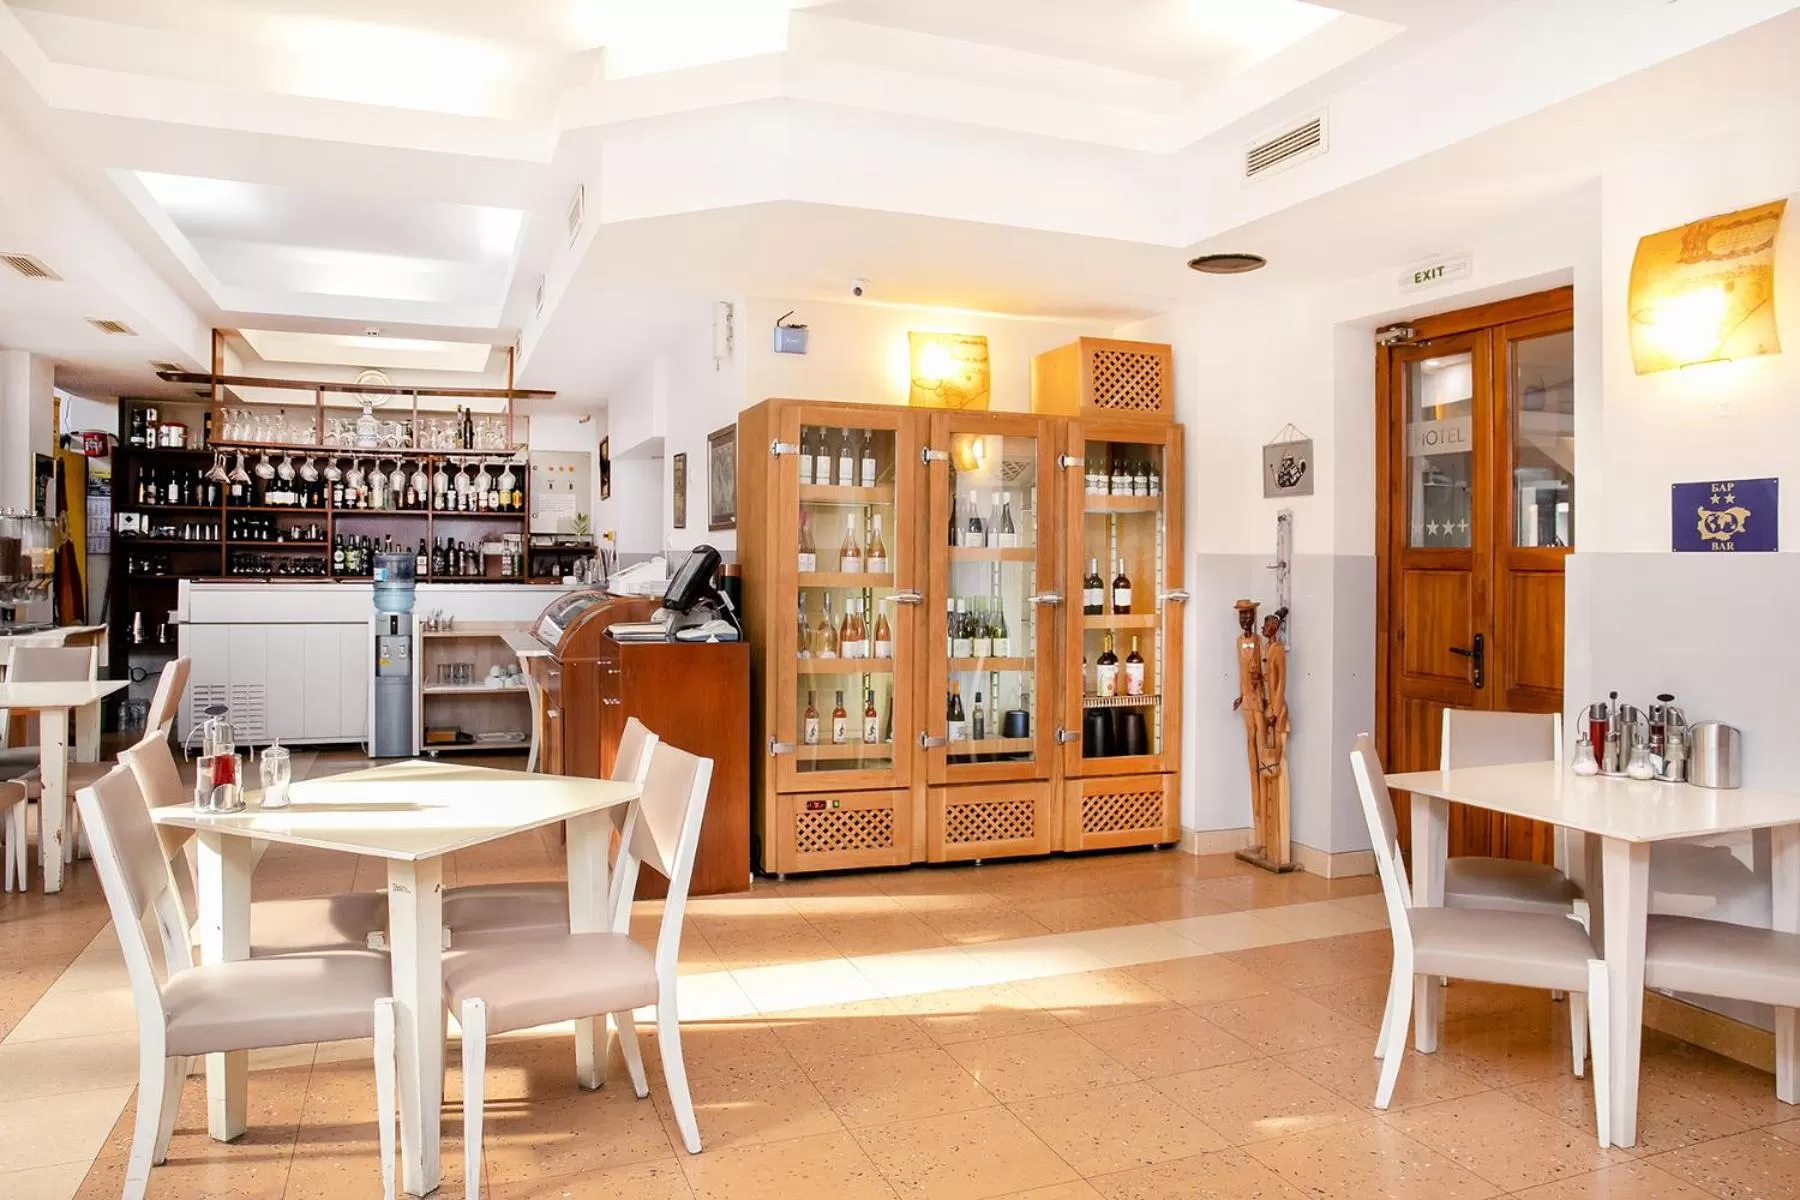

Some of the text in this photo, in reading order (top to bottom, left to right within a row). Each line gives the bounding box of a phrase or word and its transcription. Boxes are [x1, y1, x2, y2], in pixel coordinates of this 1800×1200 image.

[1414, 265, 1445, 284] EXIT
[1711, 483, 1735, 492] БАР
[1711, 542, 1735, 551] BAR
